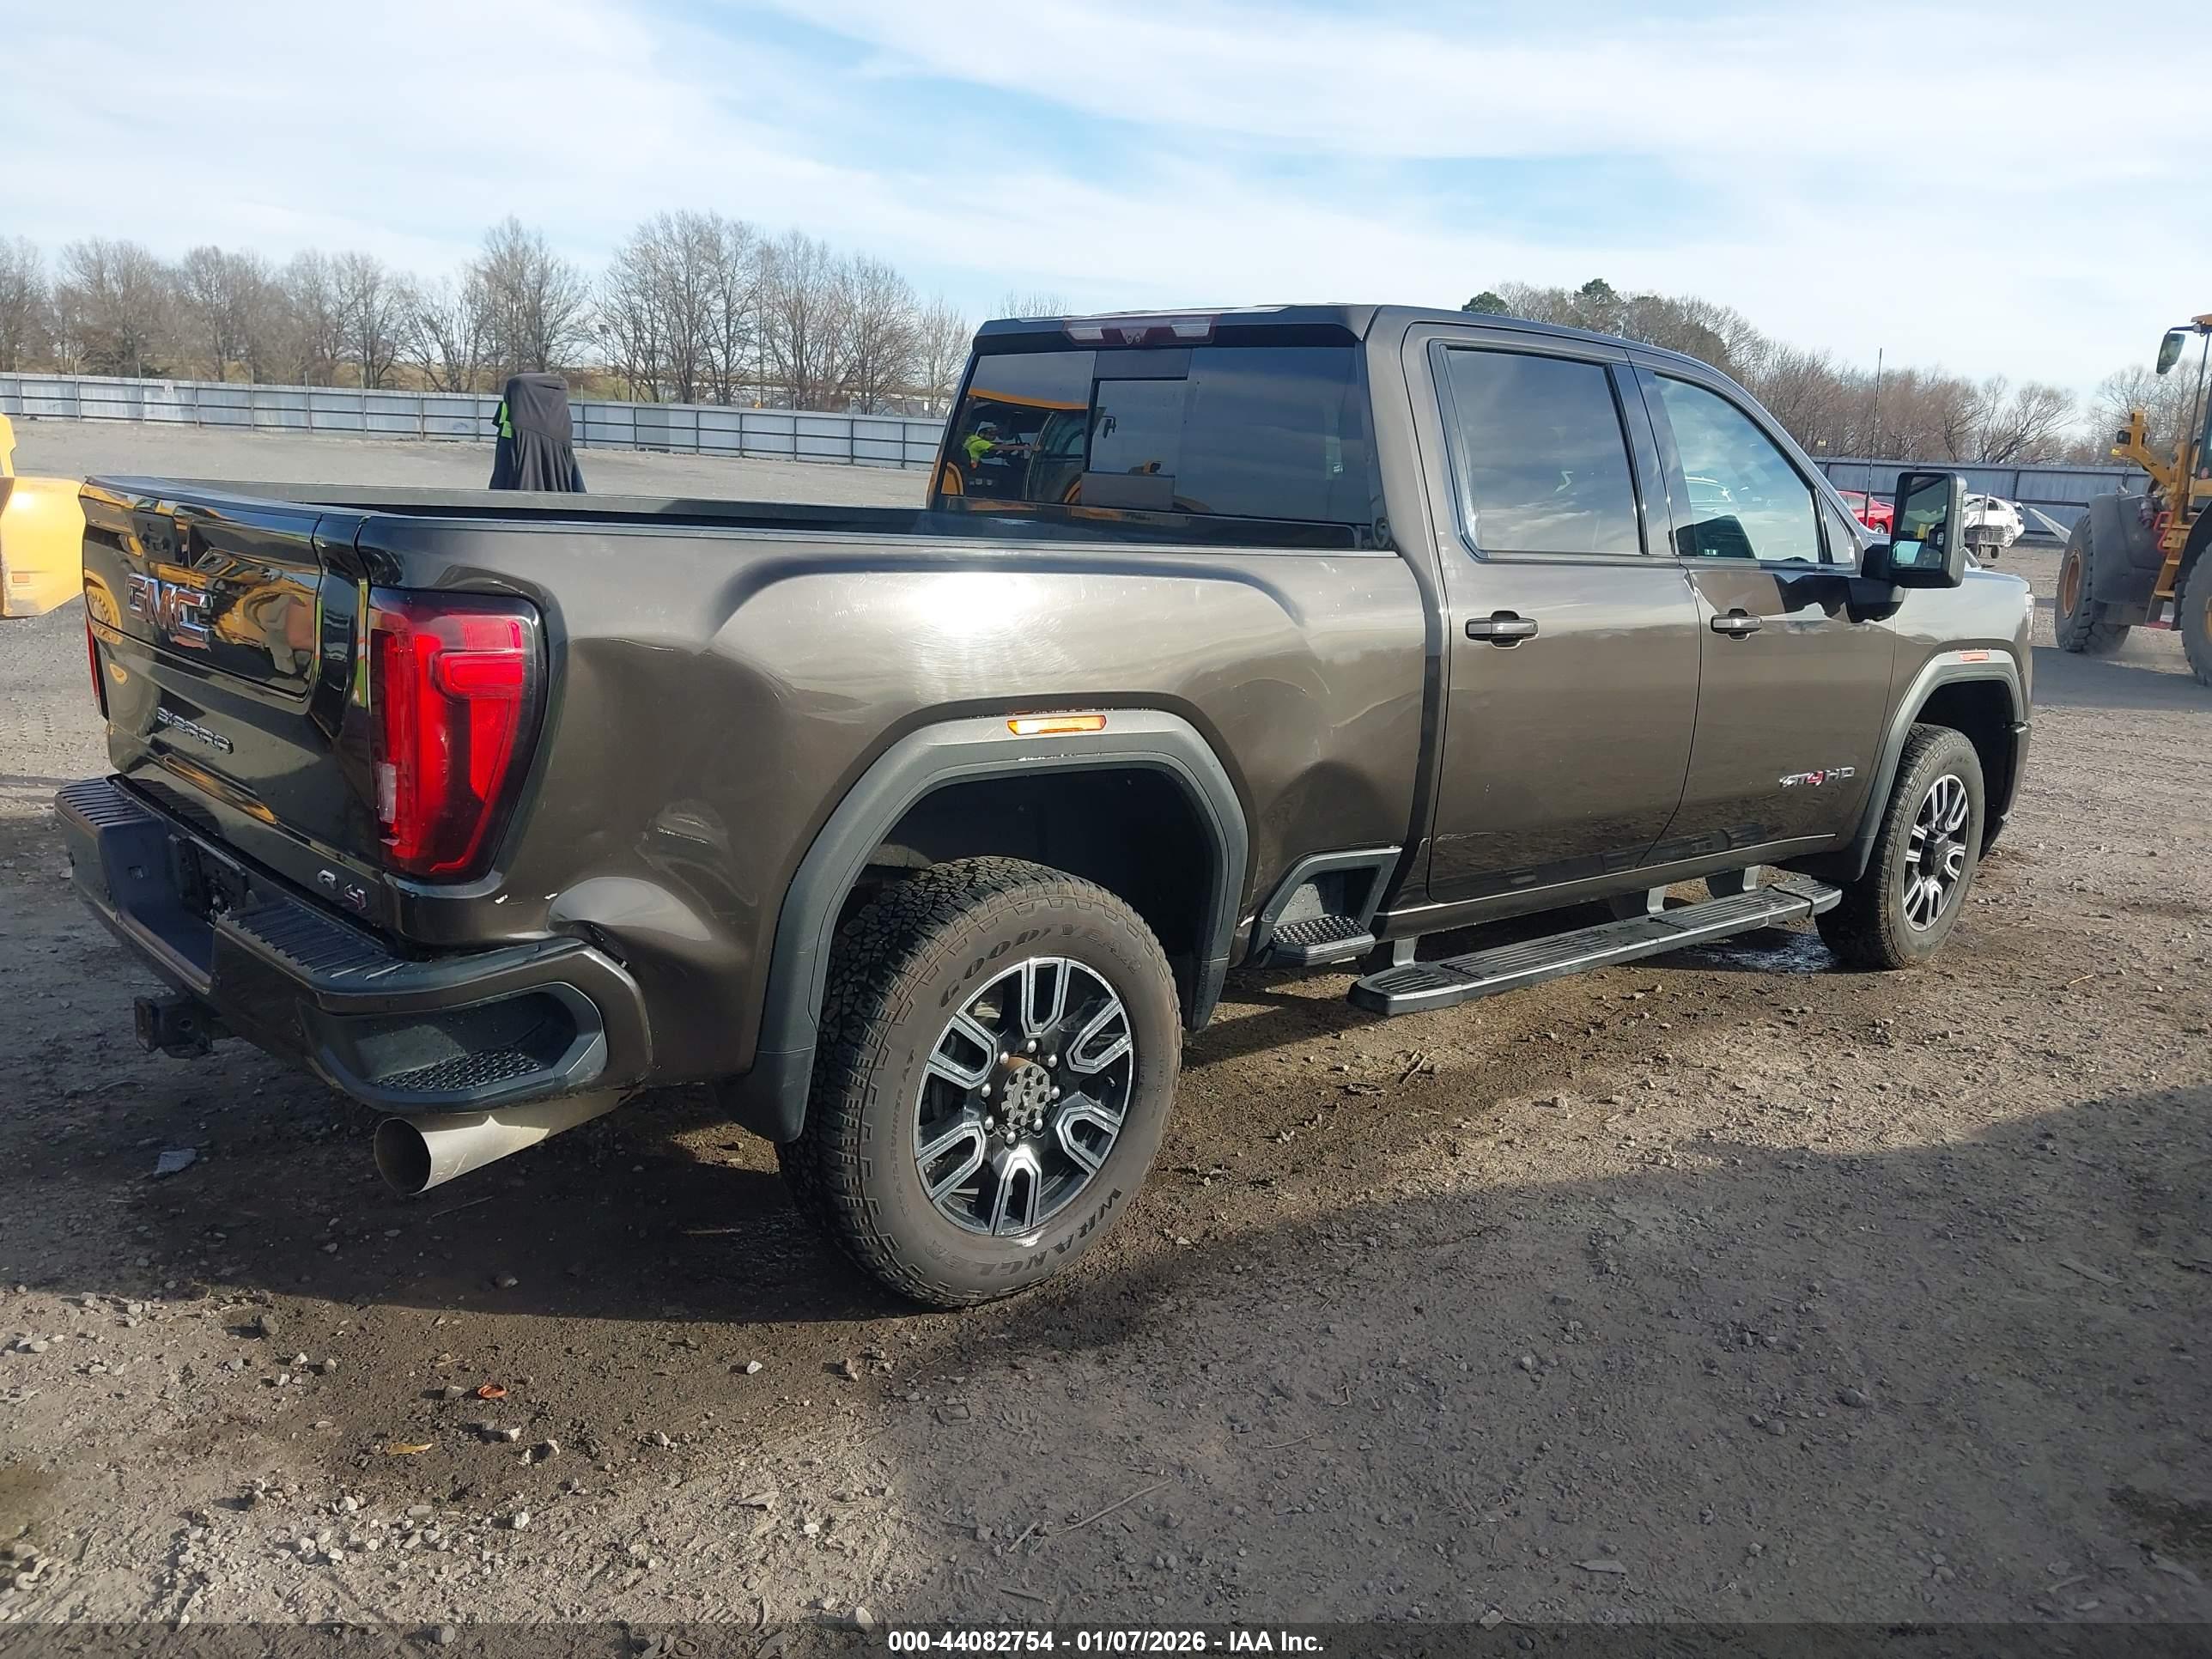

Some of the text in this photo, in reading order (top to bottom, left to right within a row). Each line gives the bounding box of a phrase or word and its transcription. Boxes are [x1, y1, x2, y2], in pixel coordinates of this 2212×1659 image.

[125, 572, 213, 645] GMC
[939, 922, 1143, 1009] GOODYEAR
[924, 1188, 1123, 1277] WRANGLER
